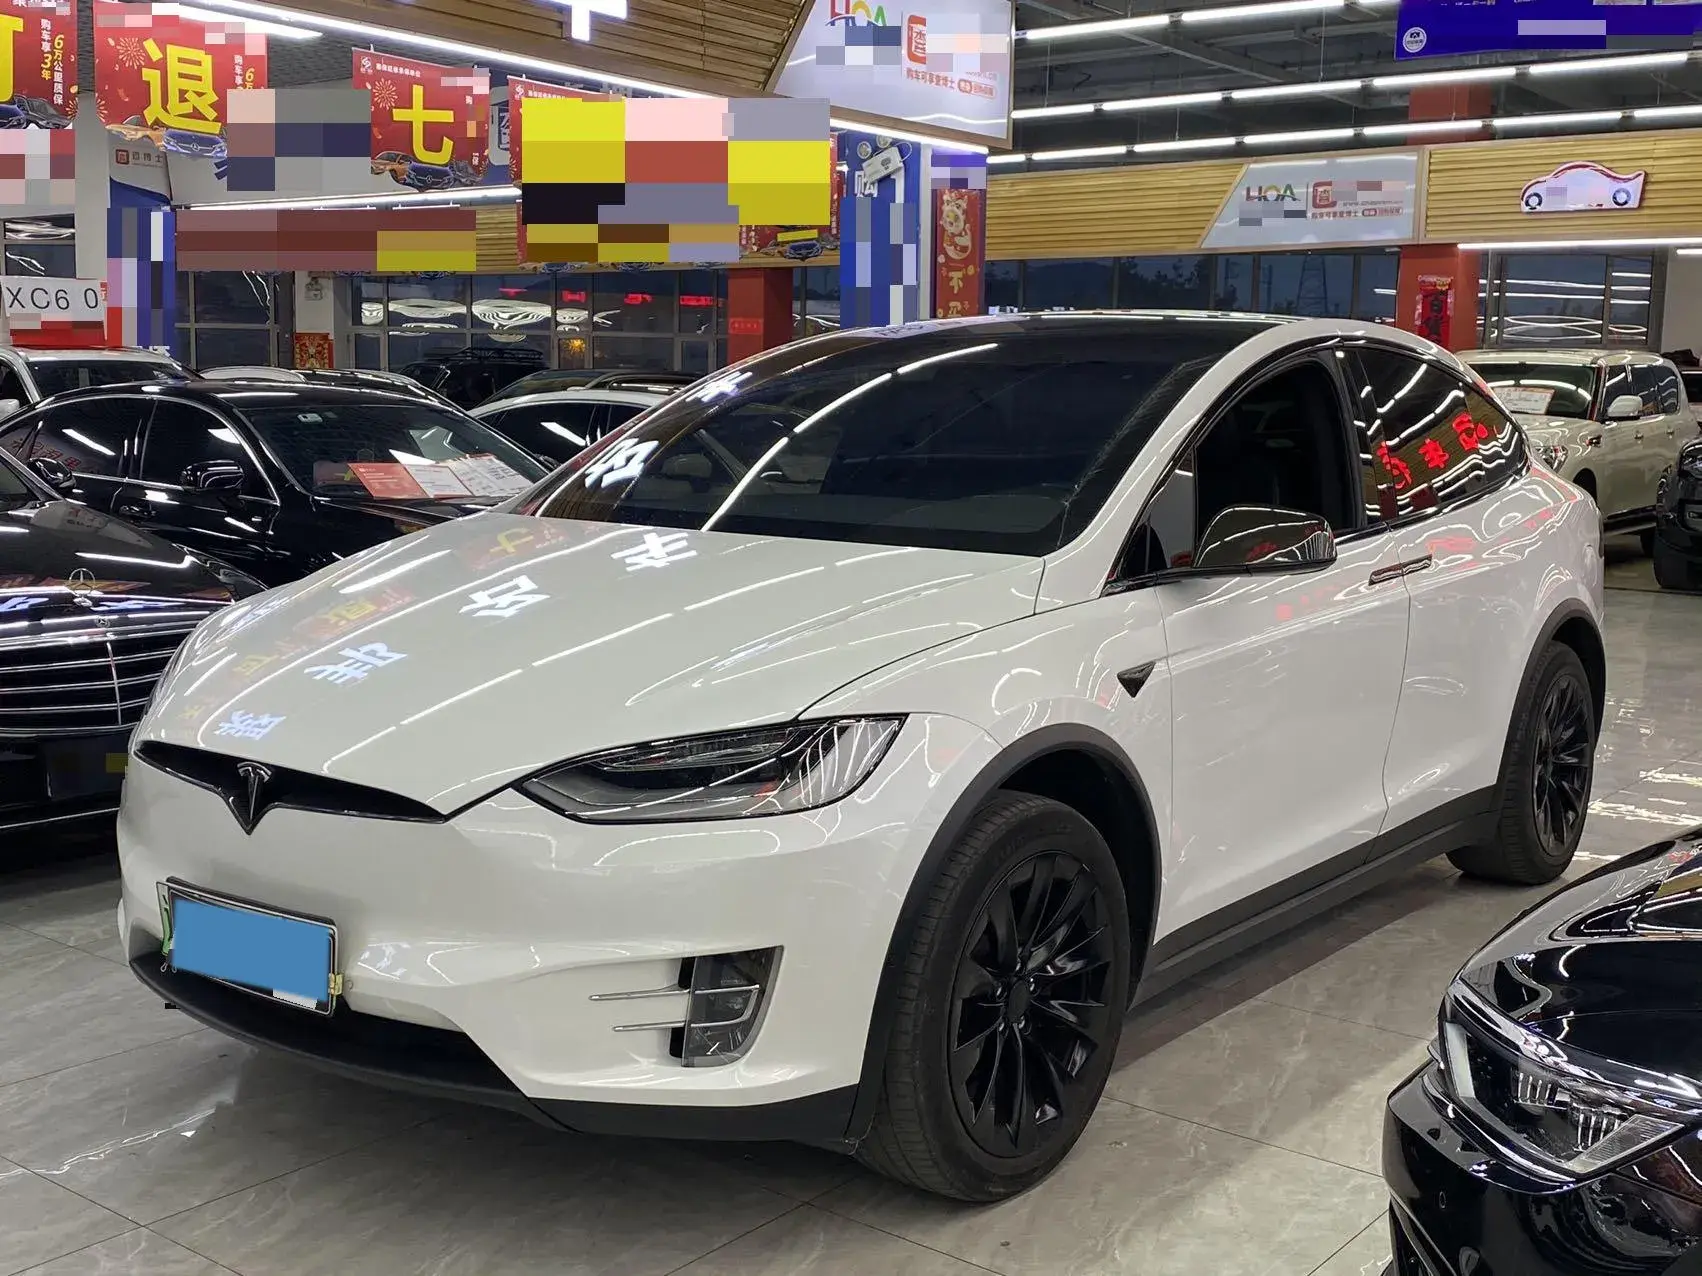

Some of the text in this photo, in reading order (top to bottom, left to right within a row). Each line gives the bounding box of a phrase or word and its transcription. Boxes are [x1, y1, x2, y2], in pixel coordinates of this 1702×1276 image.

[41, 19, 52, 80] 购车享3年
[53, 34, 64, 105] 6万公里质保
[142, 38, 223, 135] 退
[392, 84, 455, 165] 七
